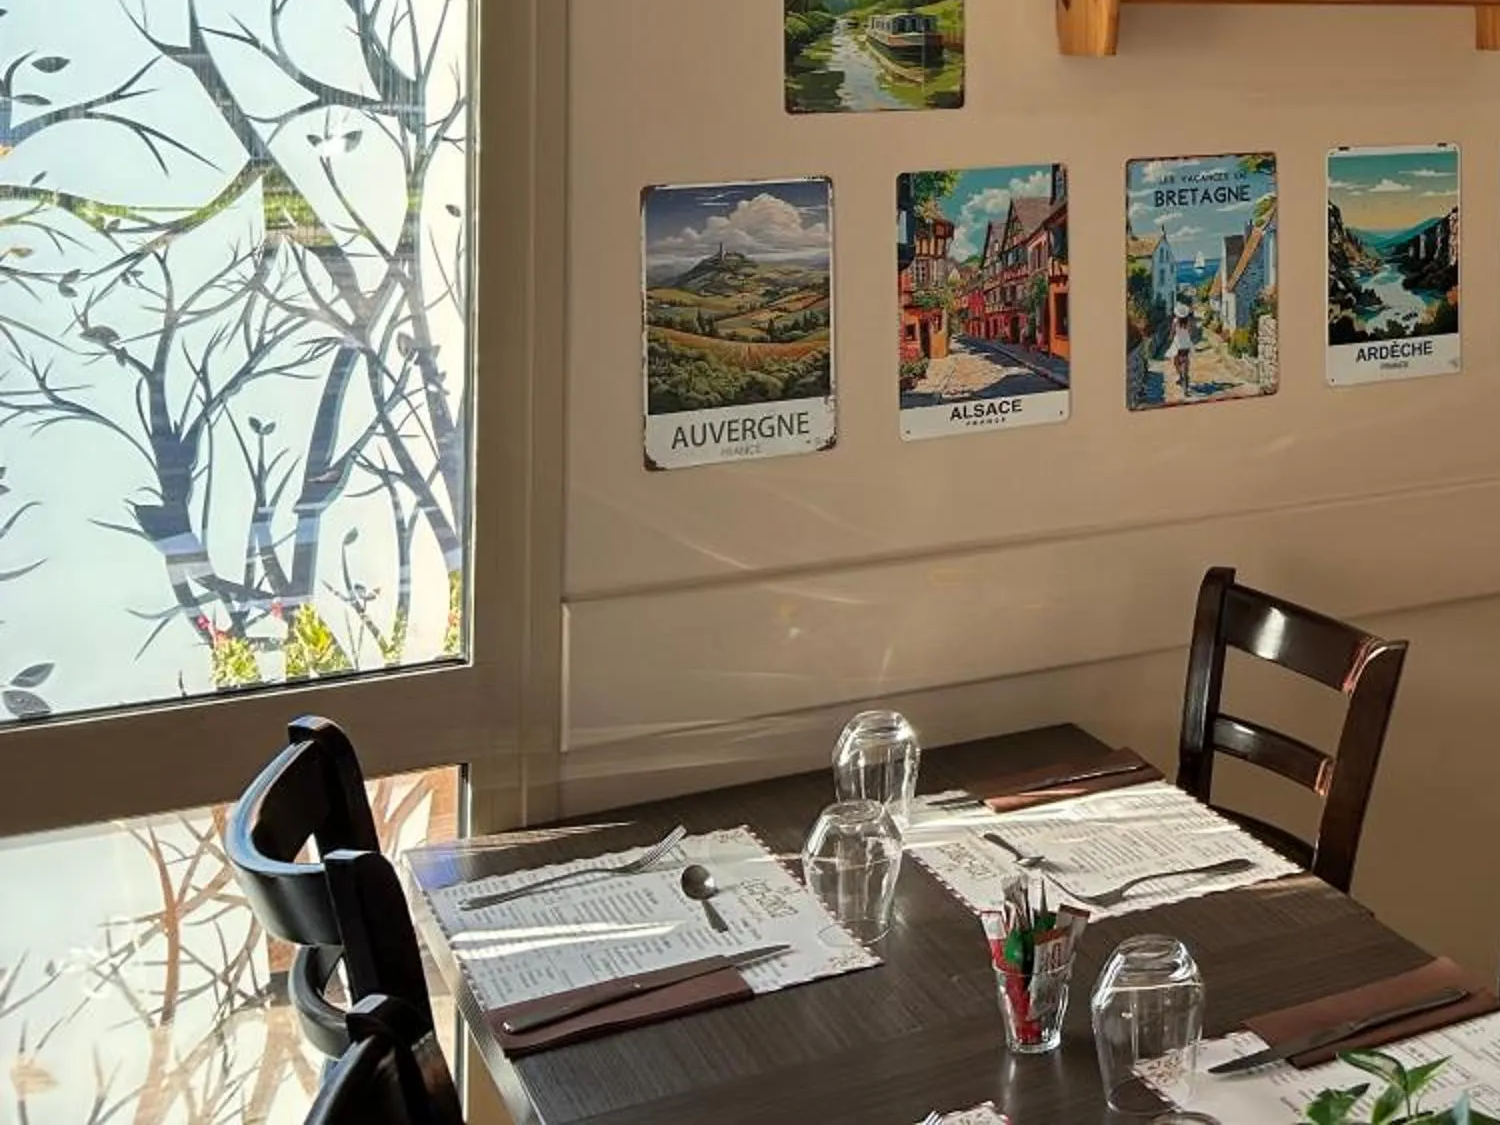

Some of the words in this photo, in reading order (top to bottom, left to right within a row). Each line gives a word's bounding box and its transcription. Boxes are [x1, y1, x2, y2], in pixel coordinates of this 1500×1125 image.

[1154, 185, 1252, 208] BRETAGNE
[1355, 340, 1433, 363] ARDÈCHE
[950, 399, 1023, 421] ALSACE
[671, 411, 809, 450] AUVERGNE
